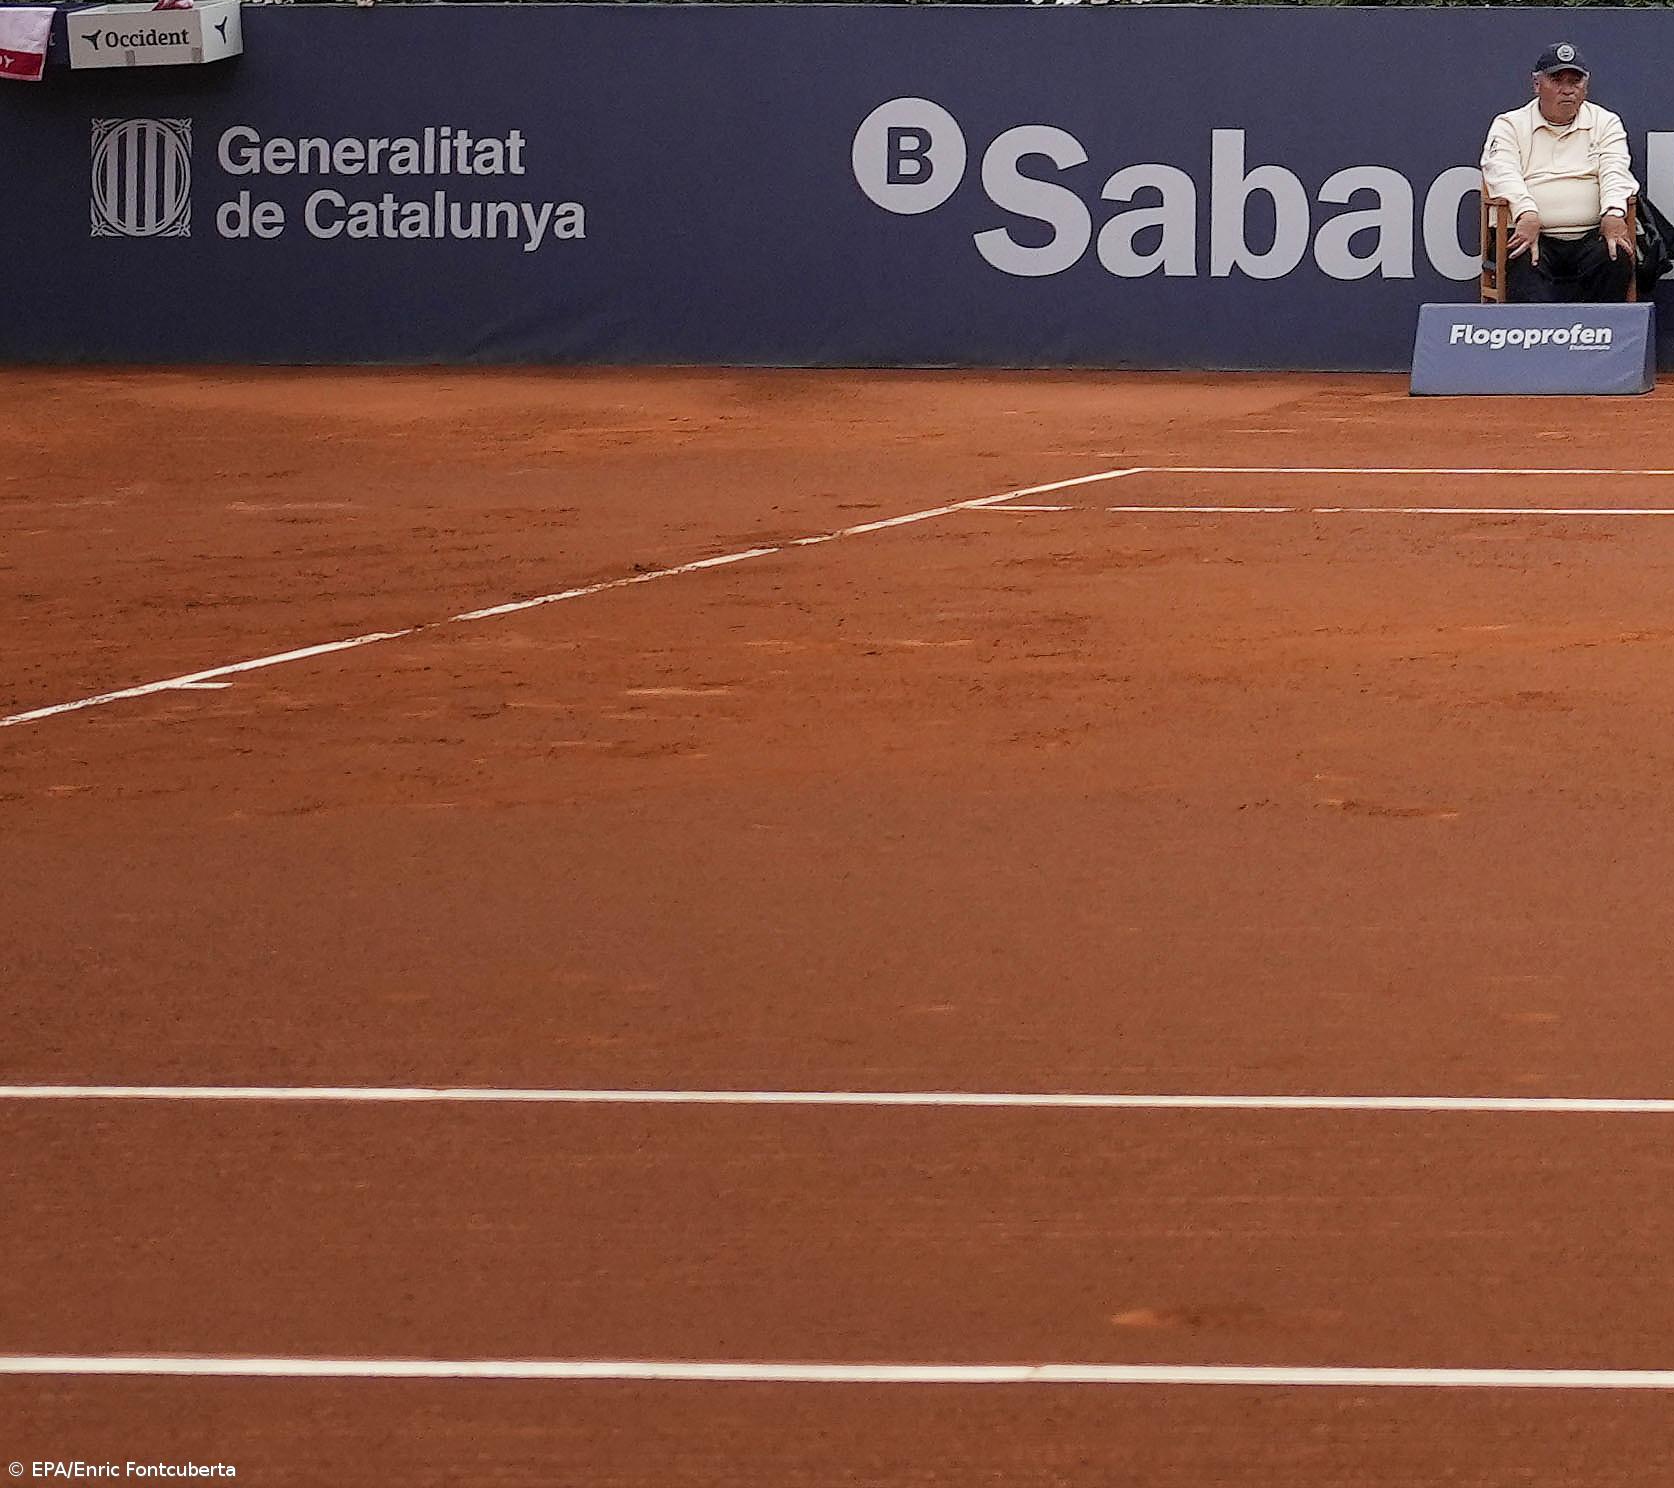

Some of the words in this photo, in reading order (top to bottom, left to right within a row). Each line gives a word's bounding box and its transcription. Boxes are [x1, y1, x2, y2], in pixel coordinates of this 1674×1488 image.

[105, 29, 190, 48] Occident
[218, 126, 526, 176] Generalitat
[886, 127, 933, 185] B
[216, 189, 285, 240] de
[304, 189, 586, 253] Catalunya
[1450, 324, 1612, 350] Flogoprofen
